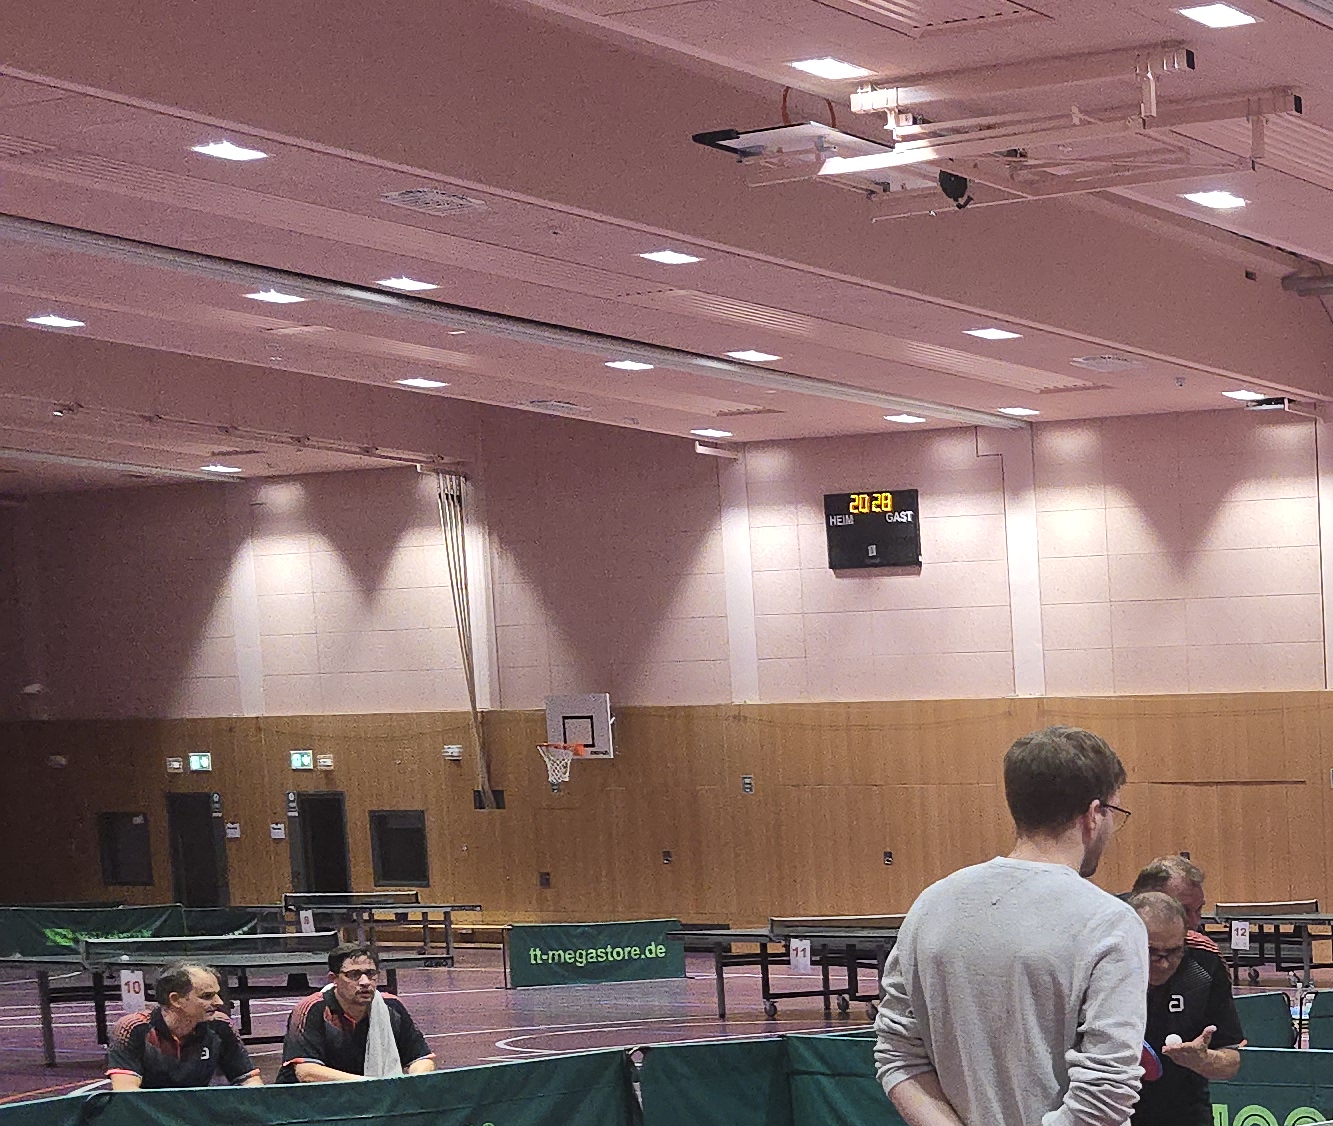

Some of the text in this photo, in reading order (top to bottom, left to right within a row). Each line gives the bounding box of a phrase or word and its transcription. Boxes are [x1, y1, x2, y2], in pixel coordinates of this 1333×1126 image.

[829, 514, 854, 526] HEIM
[886, 511, 914, 523] GAST
[1234, 927, 1247, 937] 12
[529, 941, 666, 967] tt-megastore.de
[792, 946, 807, 958] 11
[124, 980, 141, 995] 10
